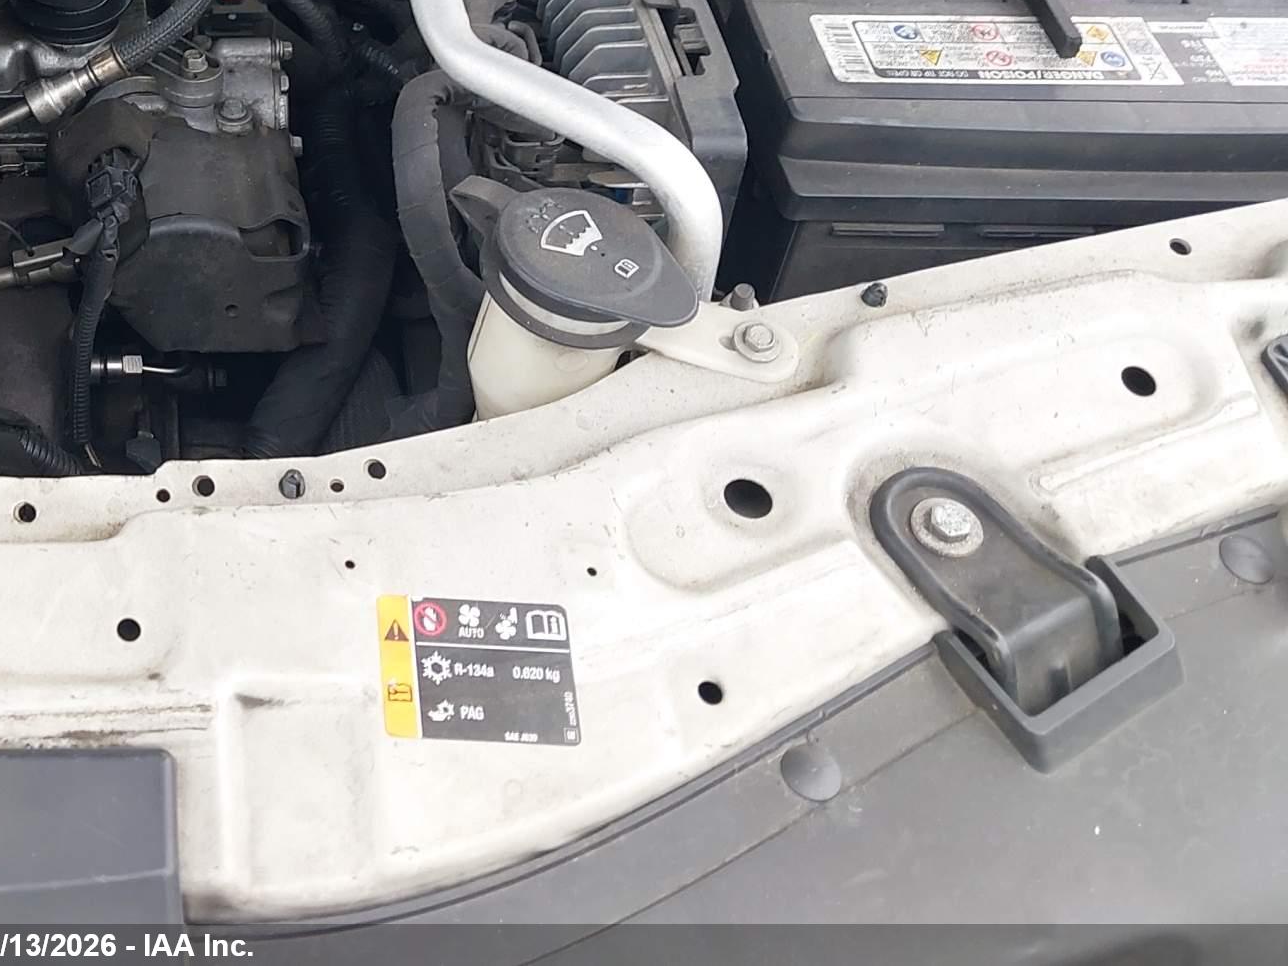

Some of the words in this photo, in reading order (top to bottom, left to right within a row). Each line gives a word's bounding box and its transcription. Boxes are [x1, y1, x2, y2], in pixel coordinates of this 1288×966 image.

[458, 626, 485, 638] AUTO
[454, 664, 495, 678] R-134a
[545, 667, 561, 684] kg
[460, 705, 485, 721] PAG
